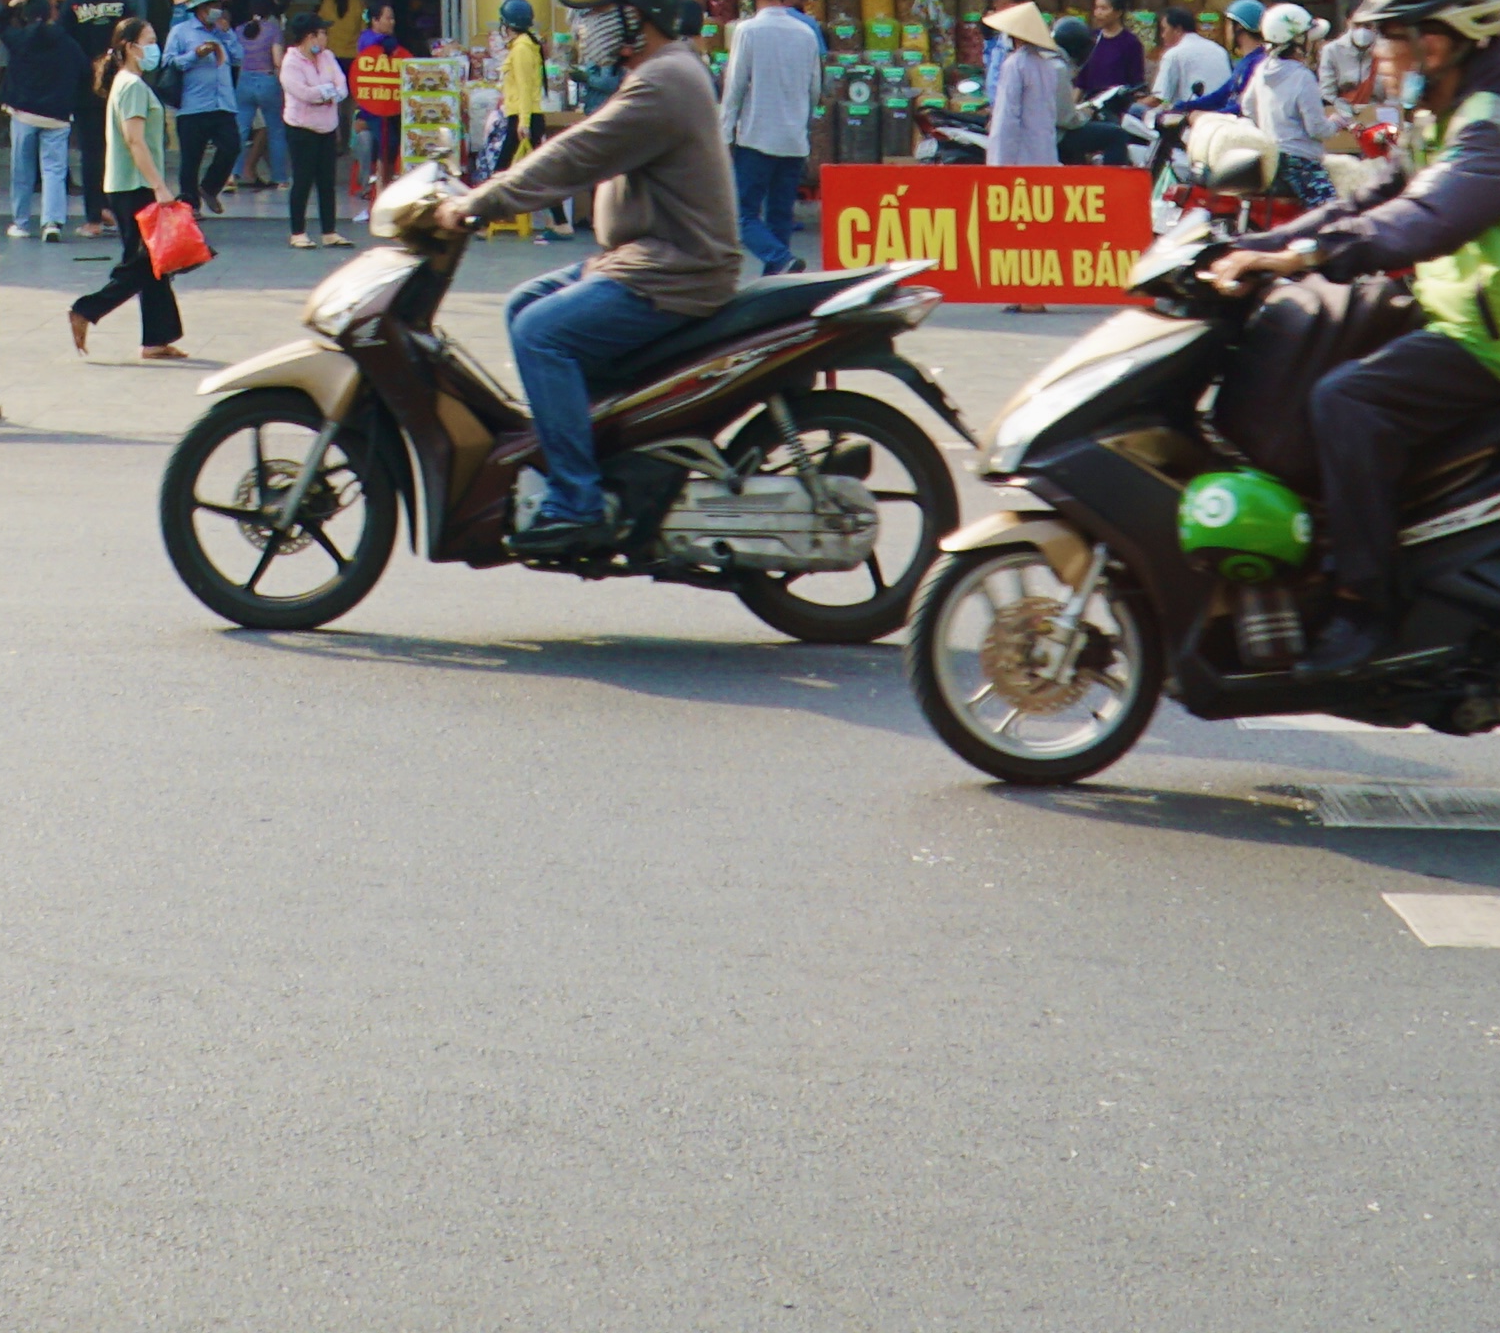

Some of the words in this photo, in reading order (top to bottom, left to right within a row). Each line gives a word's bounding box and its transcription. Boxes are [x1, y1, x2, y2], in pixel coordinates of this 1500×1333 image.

[837, 185, 958, 271] CẤM
[987, 177, 1054, 231] ĐẬU
[1063, 185, 1106, 223] XE
[989, 249, 1064, 287] MUA
[1072, 242, 1141, 287] BÁN
